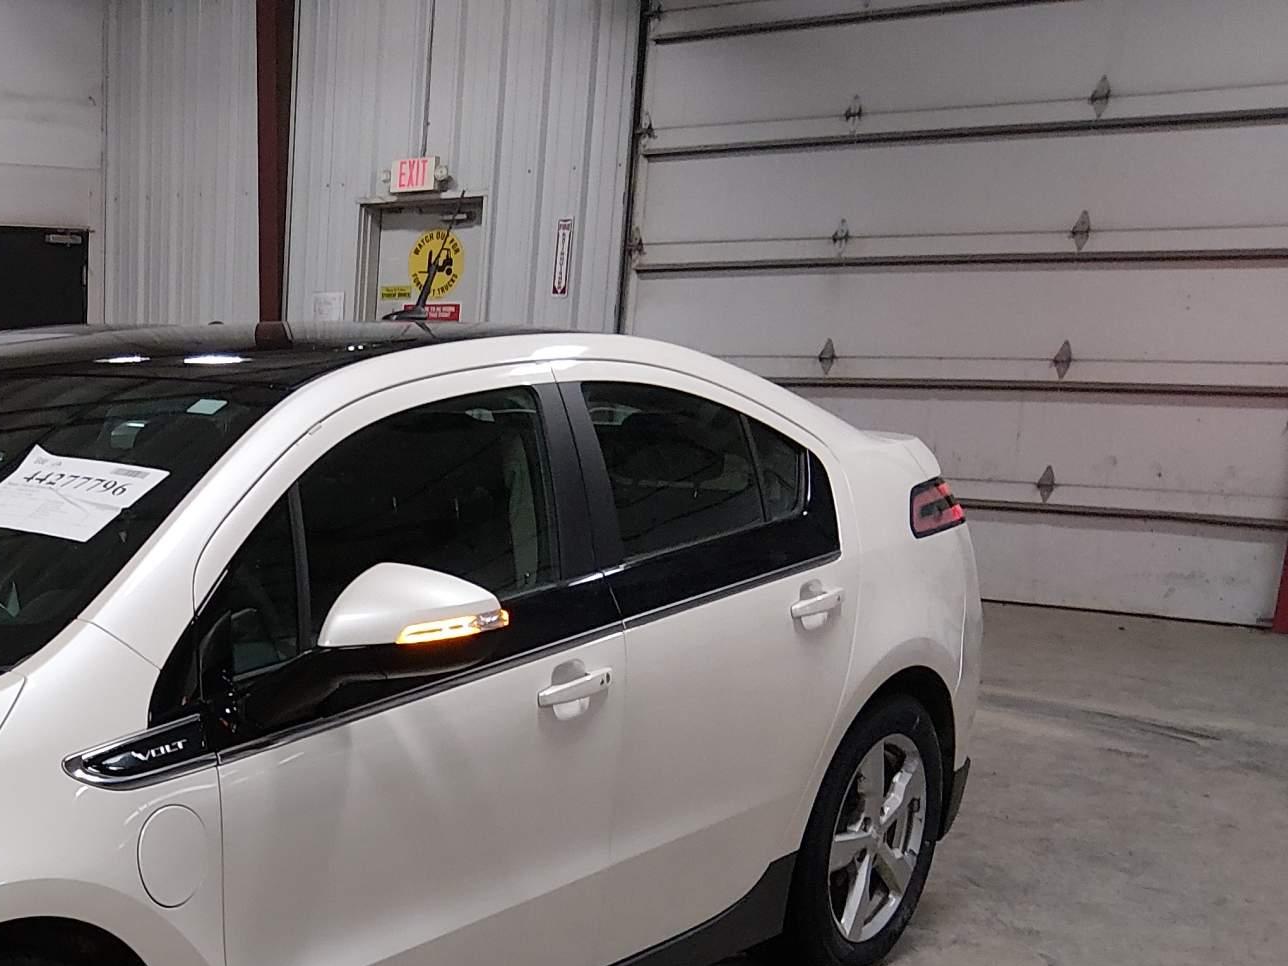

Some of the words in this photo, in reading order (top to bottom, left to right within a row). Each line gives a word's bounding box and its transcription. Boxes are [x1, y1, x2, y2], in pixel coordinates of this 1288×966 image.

[398, 159, 428, 188] EXIT
[413, 231, 434, 255] WATCH
[436, 273, 459, 296] TRUCKS
[23, 470, 134, 496] 44277796
[131, 739, 187, 761] VOLT
